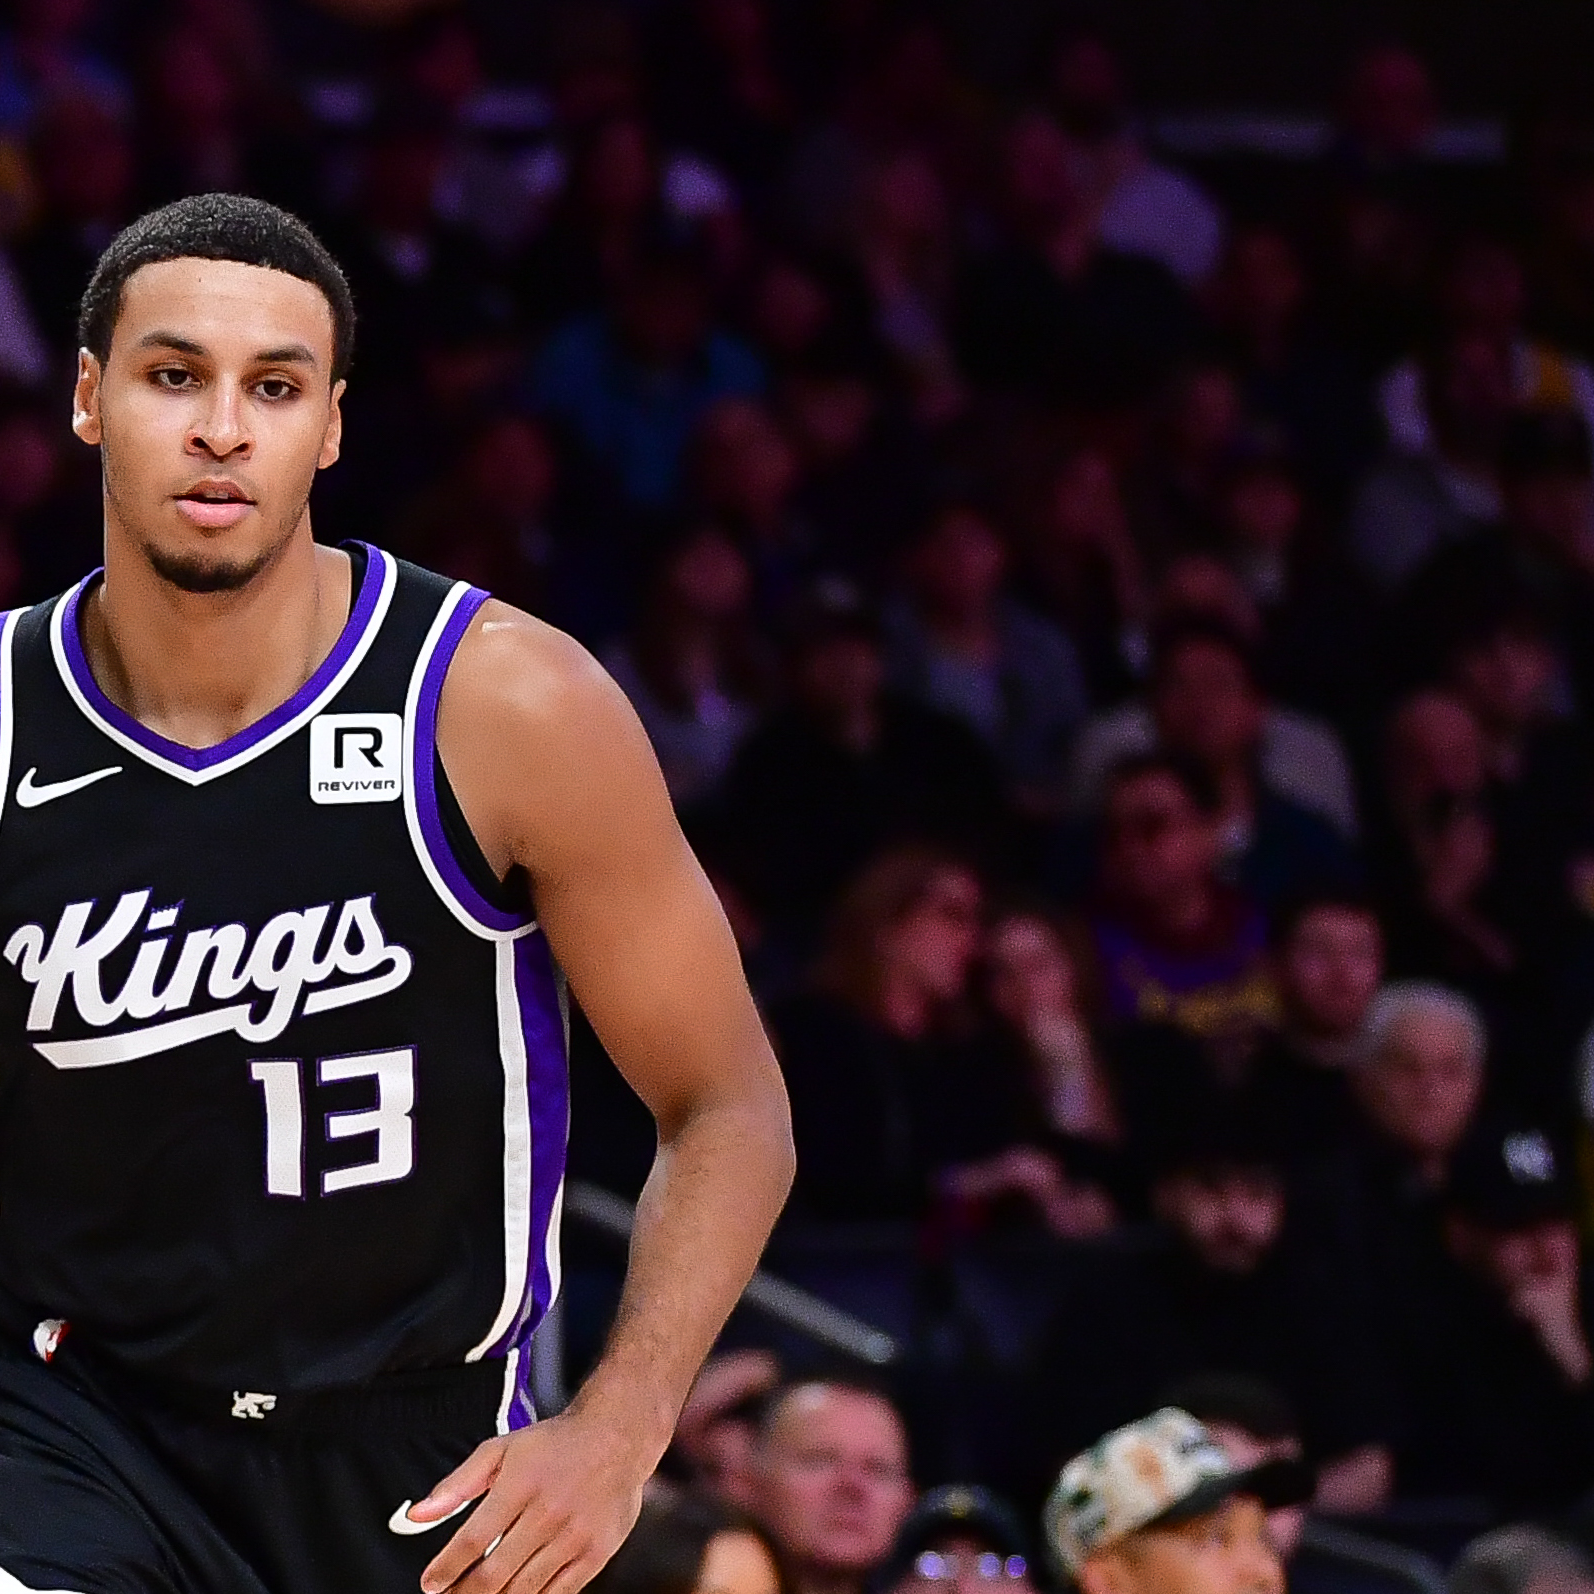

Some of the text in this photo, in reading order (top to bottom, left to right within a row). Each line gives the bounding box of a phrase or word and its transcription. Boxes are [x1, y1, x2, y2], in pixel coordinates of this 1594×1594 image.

[317, 780, 395, 792] REVIVER
[333, 727, 384, 769] R
[4, 887, 412, 1069] Kings
[248, 1046, 418, 1199] 13
